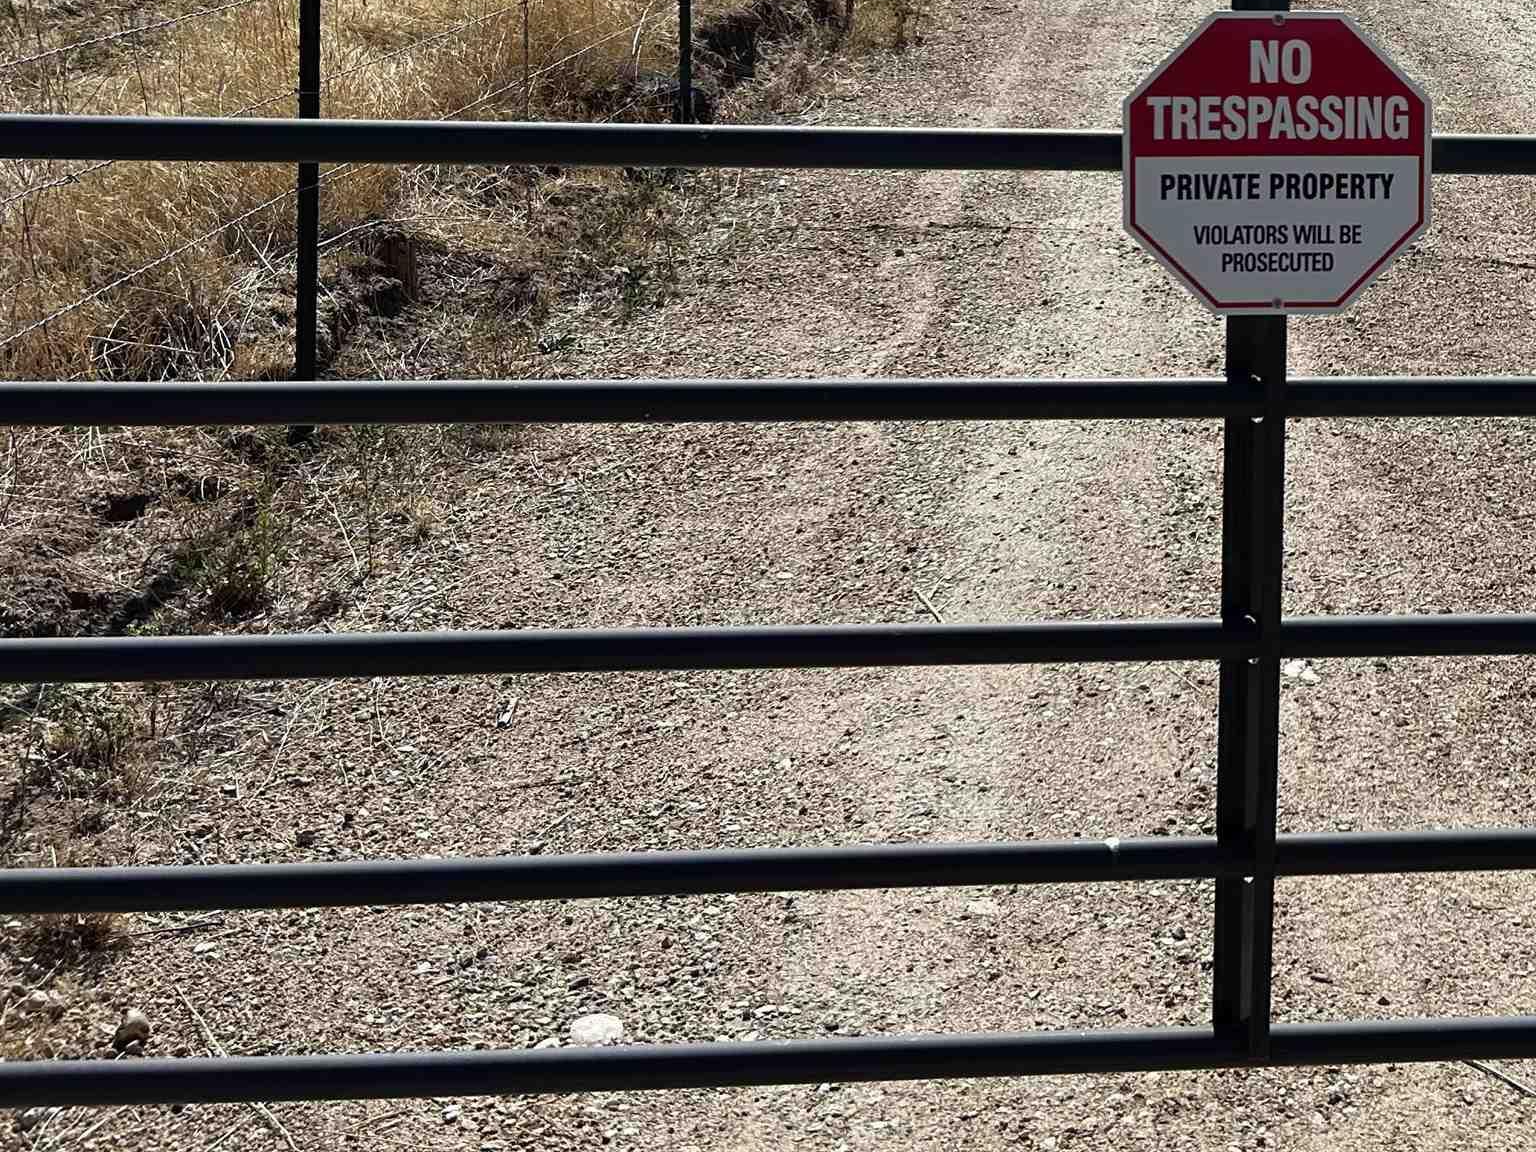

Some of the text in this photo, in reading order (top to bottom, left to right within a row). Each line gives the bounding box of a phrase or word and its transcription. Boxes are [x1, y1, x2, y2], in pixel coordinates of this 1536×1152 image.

[1249, 39, 1312, 84] NO
[1147, 95, 1409, 140] TRESPASSING
[1160, 172, 1394, 200] PRIVATE PROPERTY
[1193, 224, 1362, 245] VIOLATORS WILL BE
[1221, 252, 1334, 272] PROSECUTED
